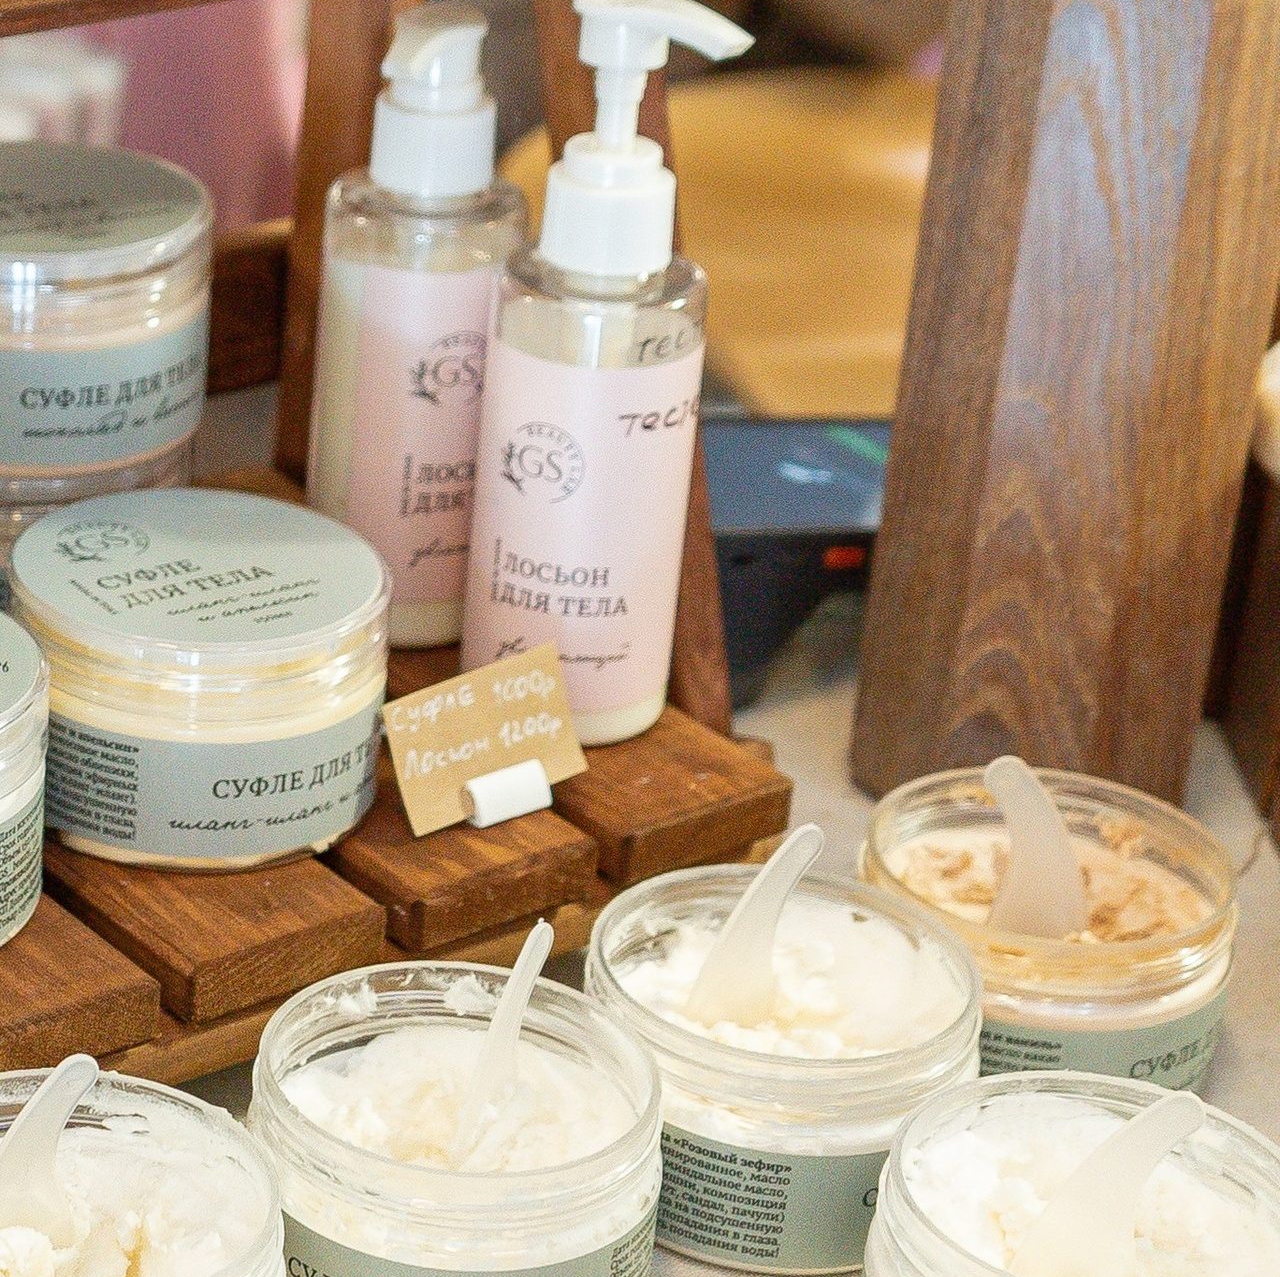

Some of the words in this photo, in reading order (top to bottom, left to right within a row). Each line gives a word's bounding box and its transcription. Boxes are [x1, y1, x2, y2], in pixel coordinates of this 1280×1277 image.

[519, 444, 563, 483] GS
[96, 558, 201, 590] СУФЛЕ
[119, 582, 187, 609] ДЛЯ
[185, 564, 274, 591] ТЕЛА
[503, 551, 612, 588] ЛОСЬОН
[557, 595, 629, 619] ТЕЛА
[212, 769, 305, 800] СУФЛЕ
[308, 750, 352, 790] ДЛЯ
